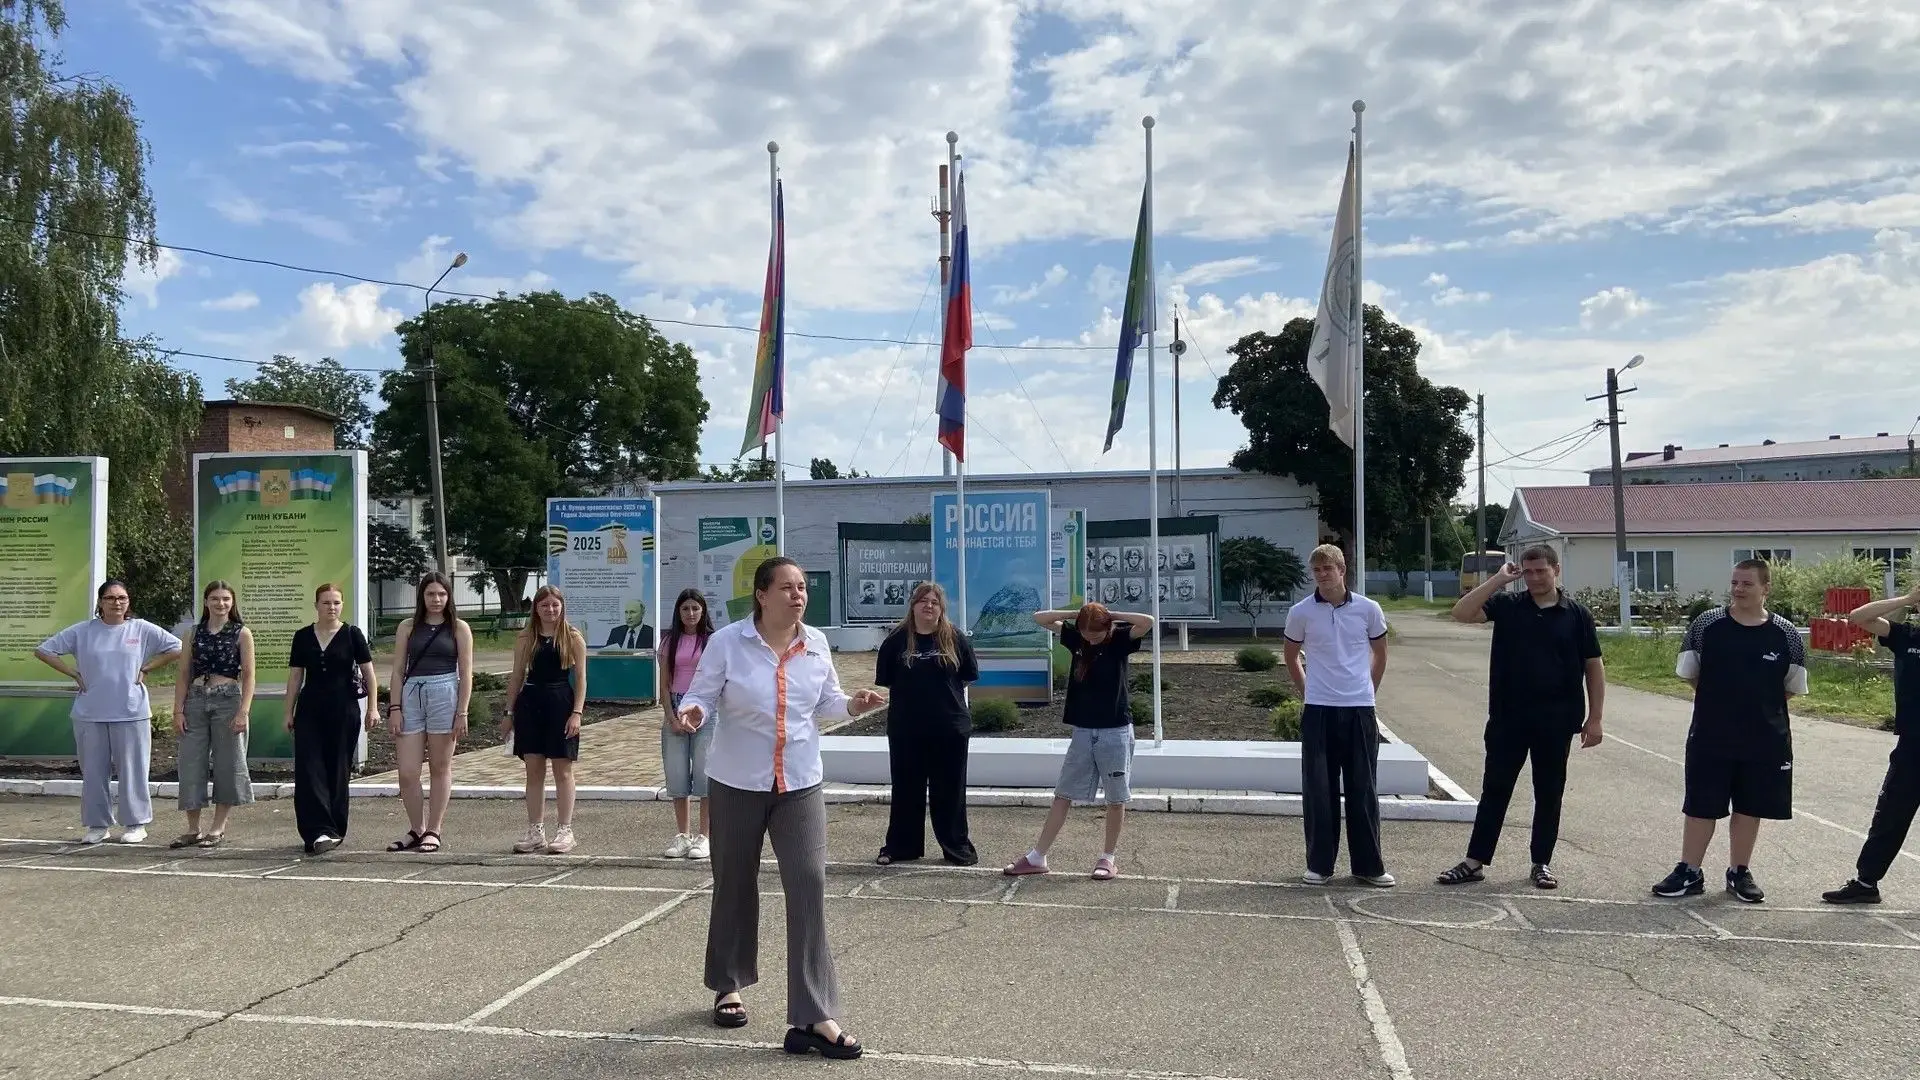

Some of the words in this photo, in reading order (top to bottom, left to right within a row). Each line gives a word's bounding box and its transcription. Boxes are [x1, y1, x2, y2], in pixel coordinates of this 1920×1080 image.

[272, 512, 307, 520] КУБАНИ
[945, 503, 1036, 532] РОССИЯ
[573, 536, 601, 550] 2025
[946, 536, 1004, 548] НАИНАЕТСЯ
[1006, 536, 1012, 548] С
[1014, 536, 1037, 548] ТЕБЯ
[859, 549, 885, 560] ГЕРОИ
[859, 562, 928, 574] СПЕЦОПЕРАЦИИ
